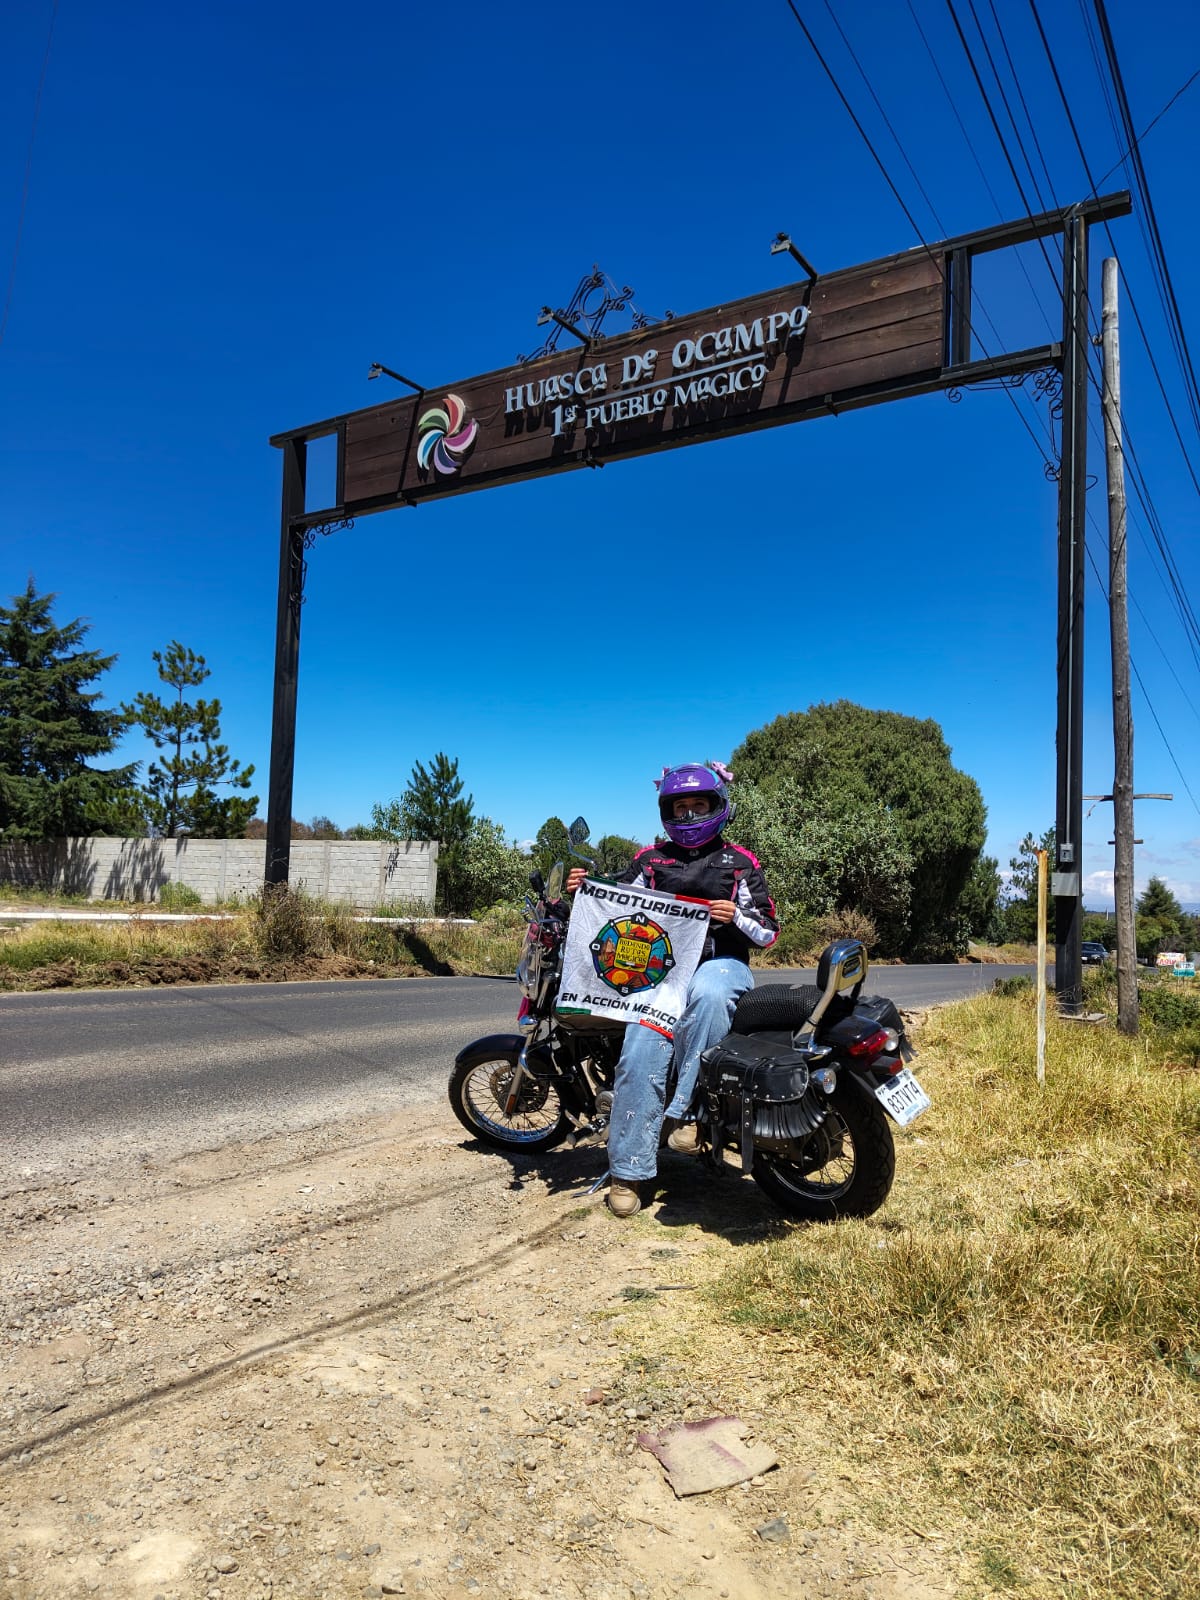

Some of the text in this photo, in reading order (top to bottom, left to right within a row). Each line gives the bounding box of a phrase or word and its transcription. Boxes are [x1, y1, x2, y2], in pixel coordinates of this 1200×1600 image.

[579, 884, 710, 921] MOTOTURISMO
[635, 916, 645, 924] N
[561, 993, 677, 1026] EN ACCIÓN MÉXICO
